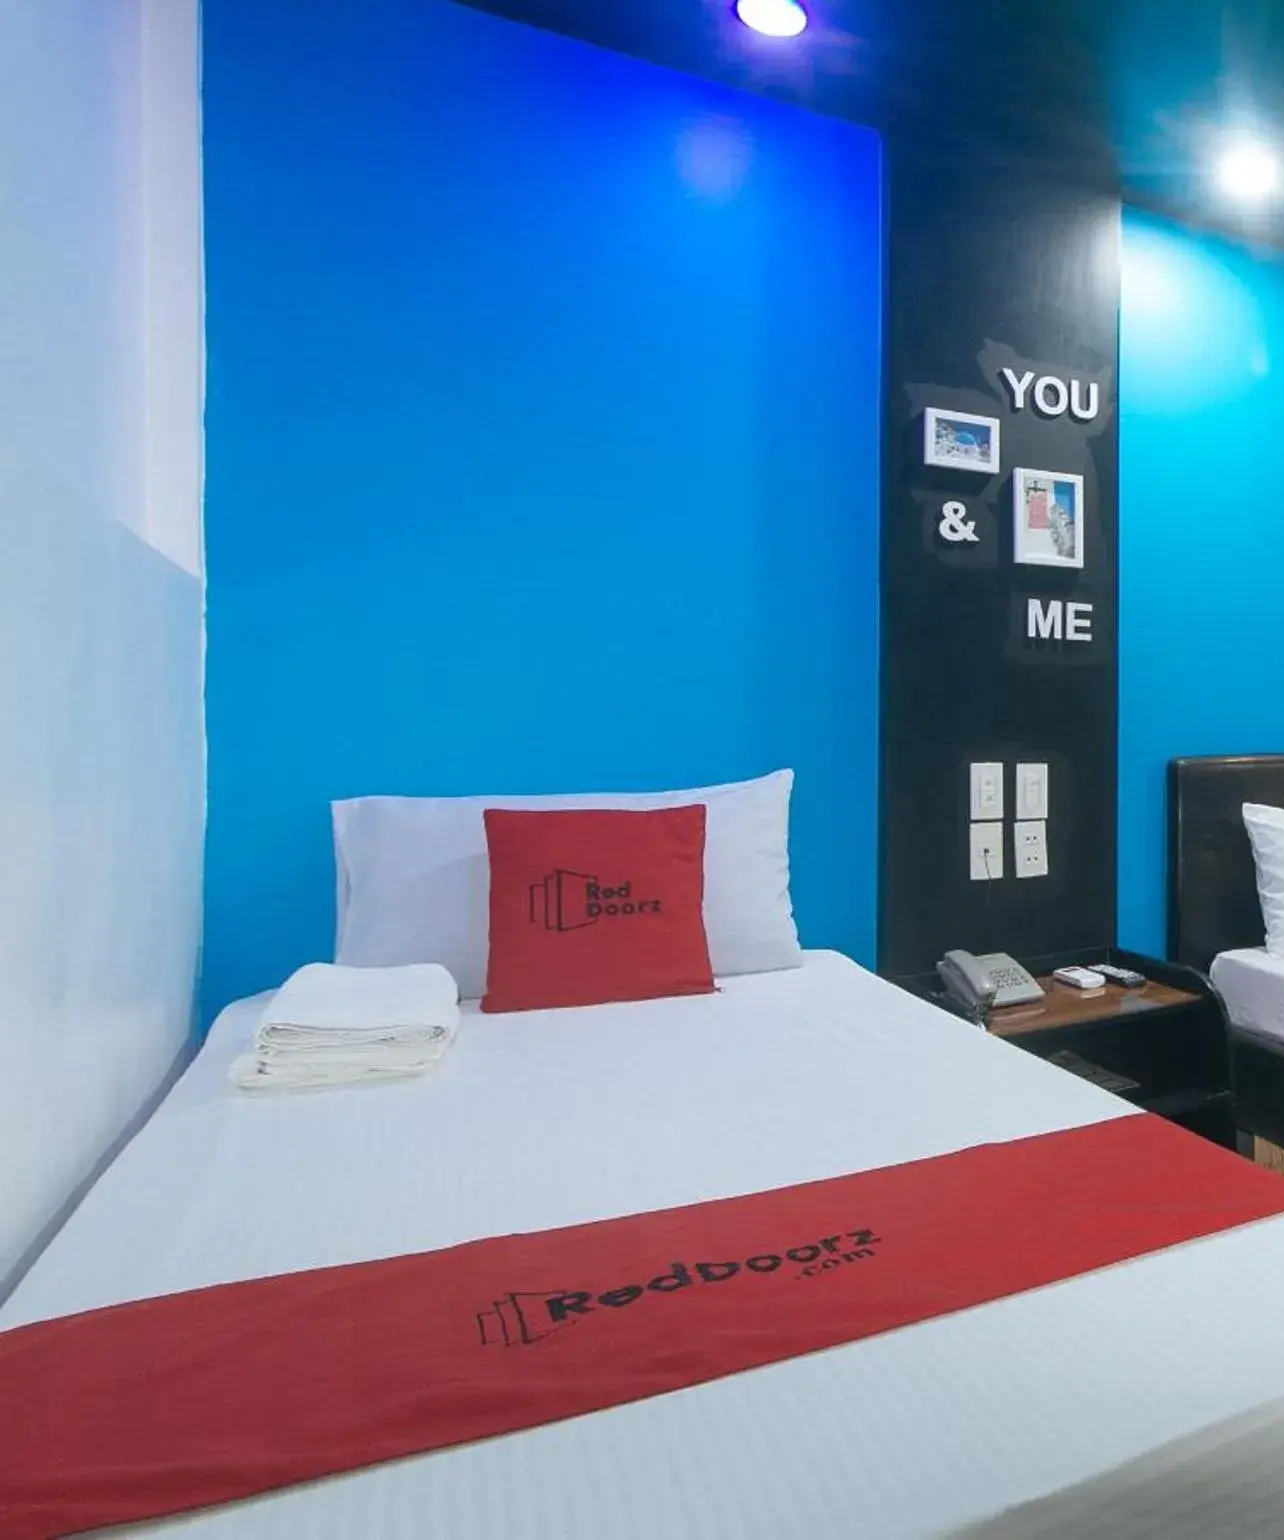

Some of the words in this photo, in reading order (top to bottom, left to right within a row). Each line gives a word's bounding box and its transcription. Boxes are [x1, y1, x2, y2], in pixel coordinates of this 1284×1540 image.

[1002, 367, 1098, 420] YOU
[938, 500, 980, 542] &
[1027, 598, 1093, 641] ME
[585, 880, 631, 899] Red
[545, 1228, 882, 1322] RedDoorz
